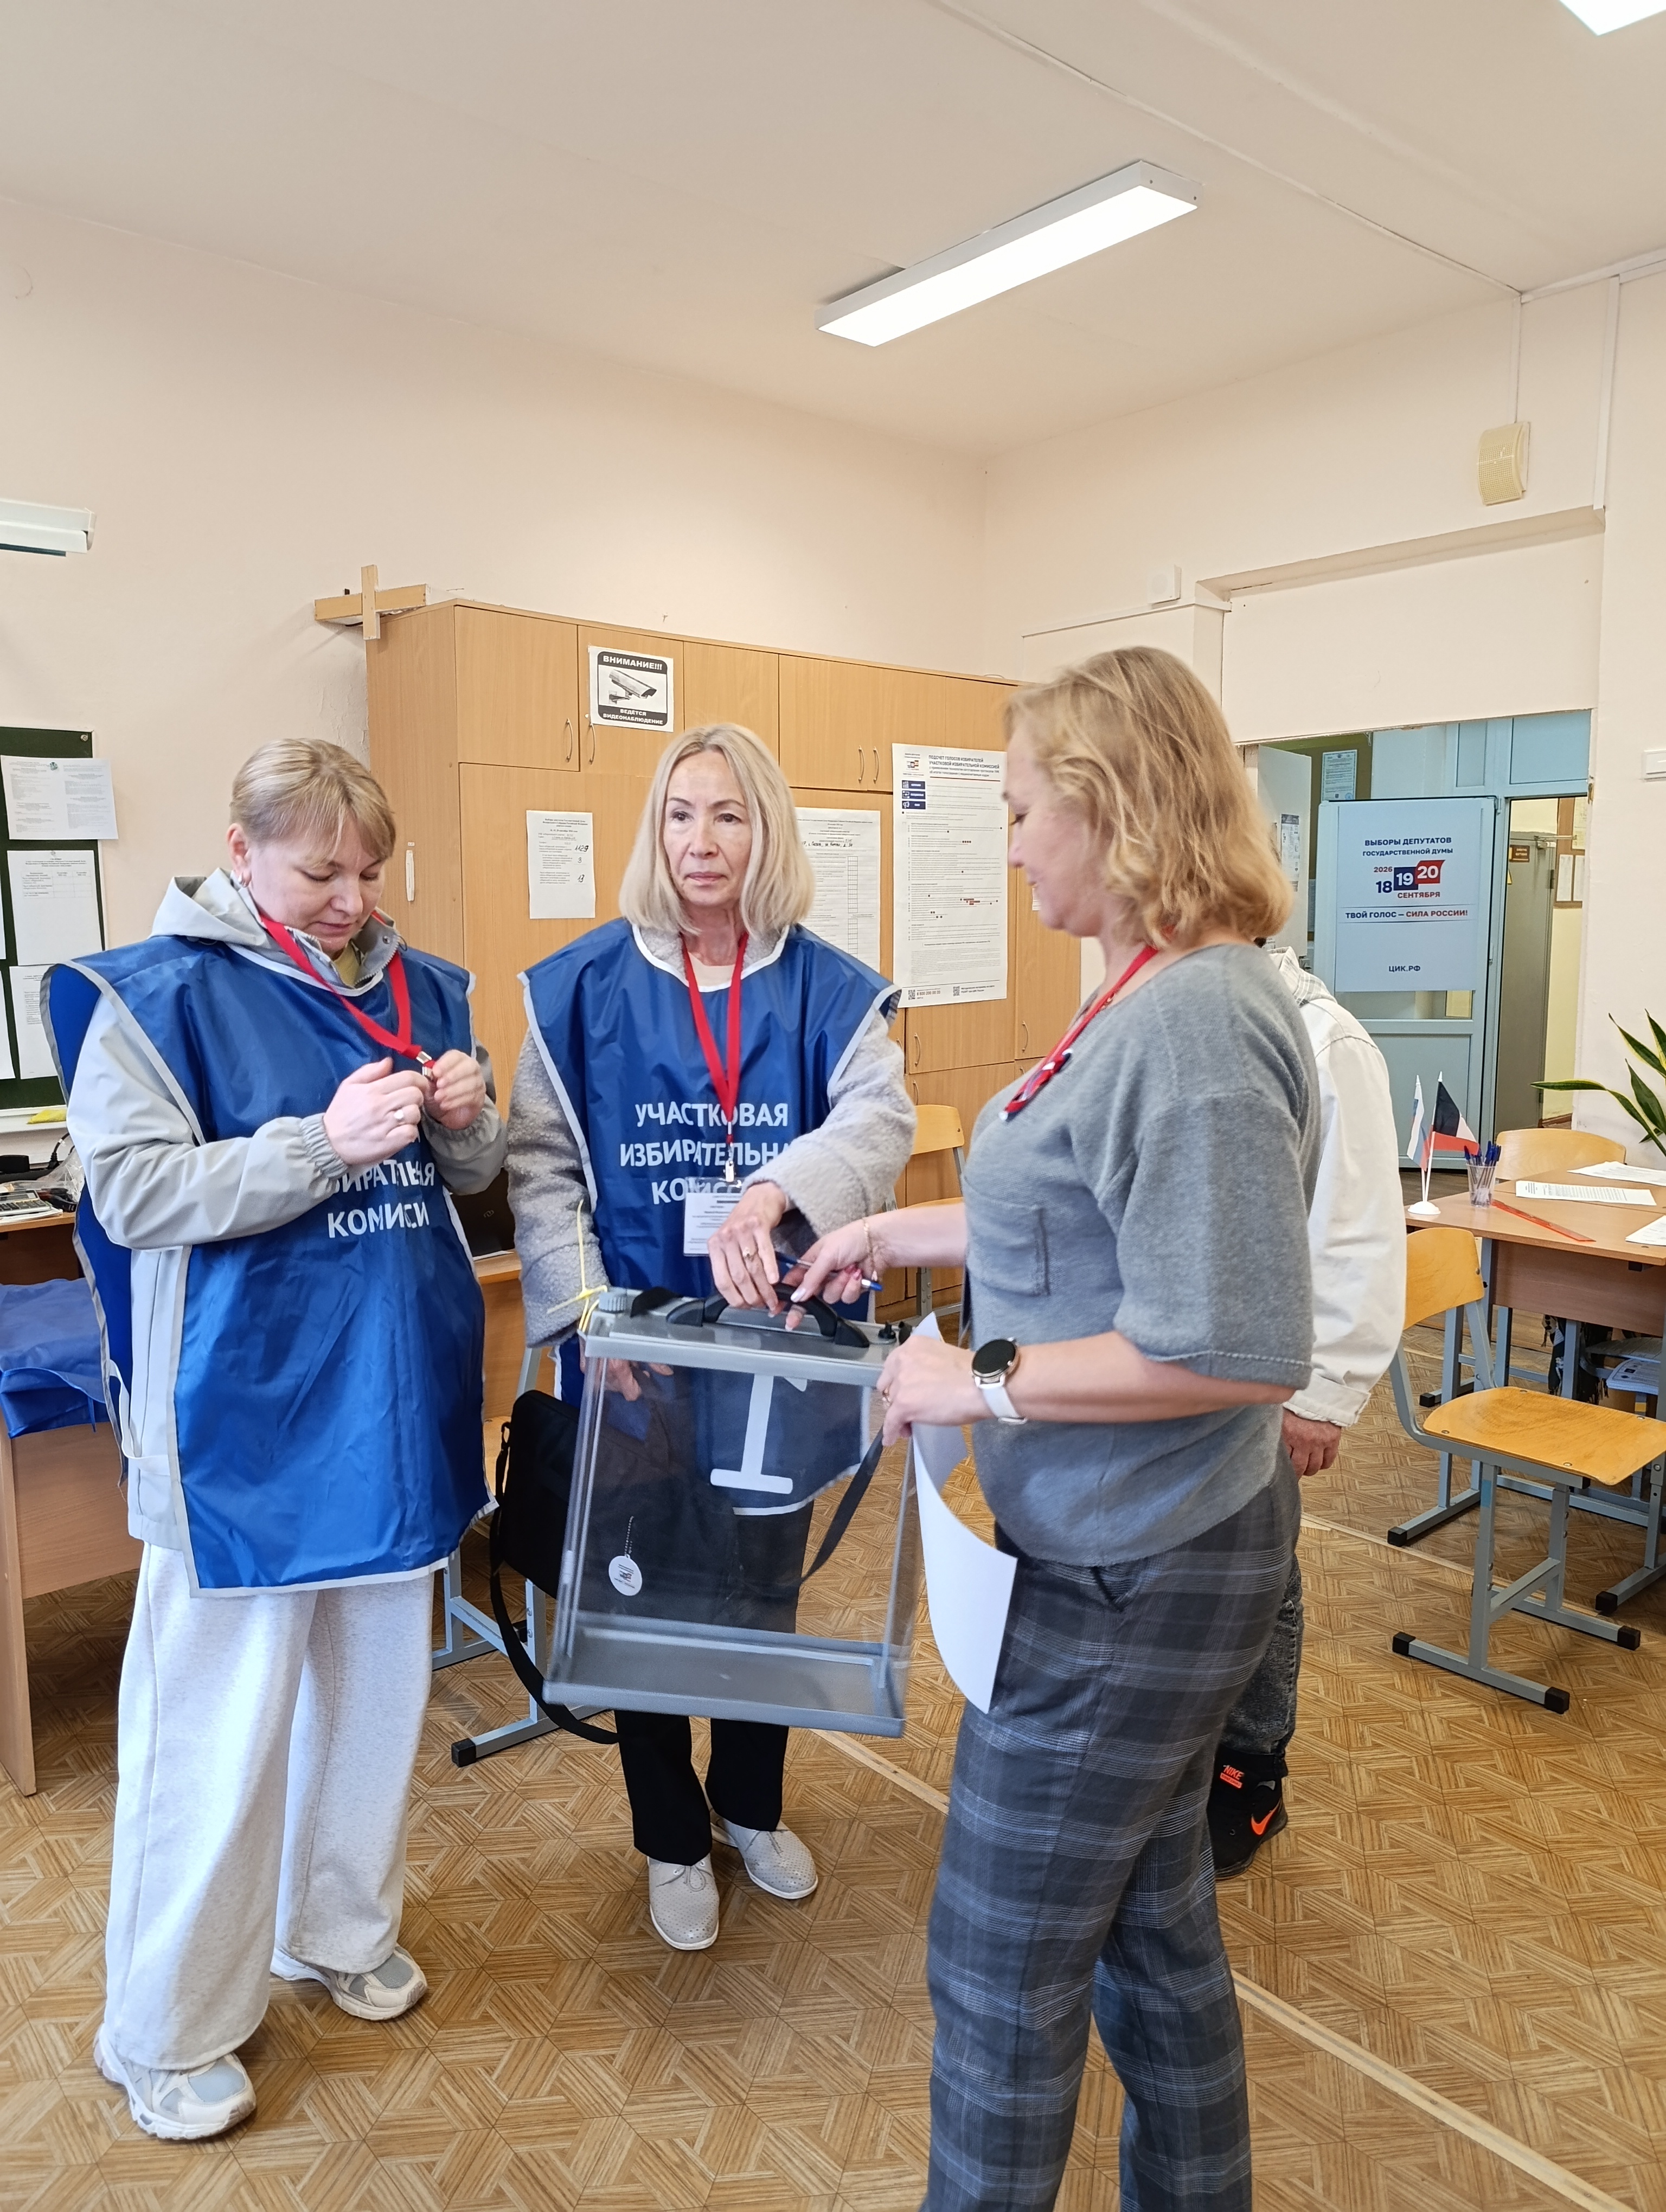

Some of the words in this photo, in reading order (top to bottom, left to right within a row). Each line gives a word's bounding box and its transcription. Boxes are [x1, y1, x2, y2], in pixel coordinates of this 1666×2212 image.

[603, 655, 662, 670] ВНИМАНИЕ!!!
[603, 713, 663, 724] ВИДЕОНАБЛЮДЕНИЕ
[1403, 838, 1452, 846] ДЕПУТАТОВ
[1362, 848, 1430, 857] ГОСУДАРСТВЕННОЙ
[1376, 881, 1392, 893] 18
[1396, 873, 1413, 885] 19
[1417, 866, 1438, 878] 20
[1345, 911, 1367, 919] ТВОЙ
[635, 1101, 789, 1127] УЧАСТКОВАЯ
[620, 1139, 789, 1167] ИЗБИРАТЕЛЬН
[1223, 1765, 1244, 1780] NIKE
